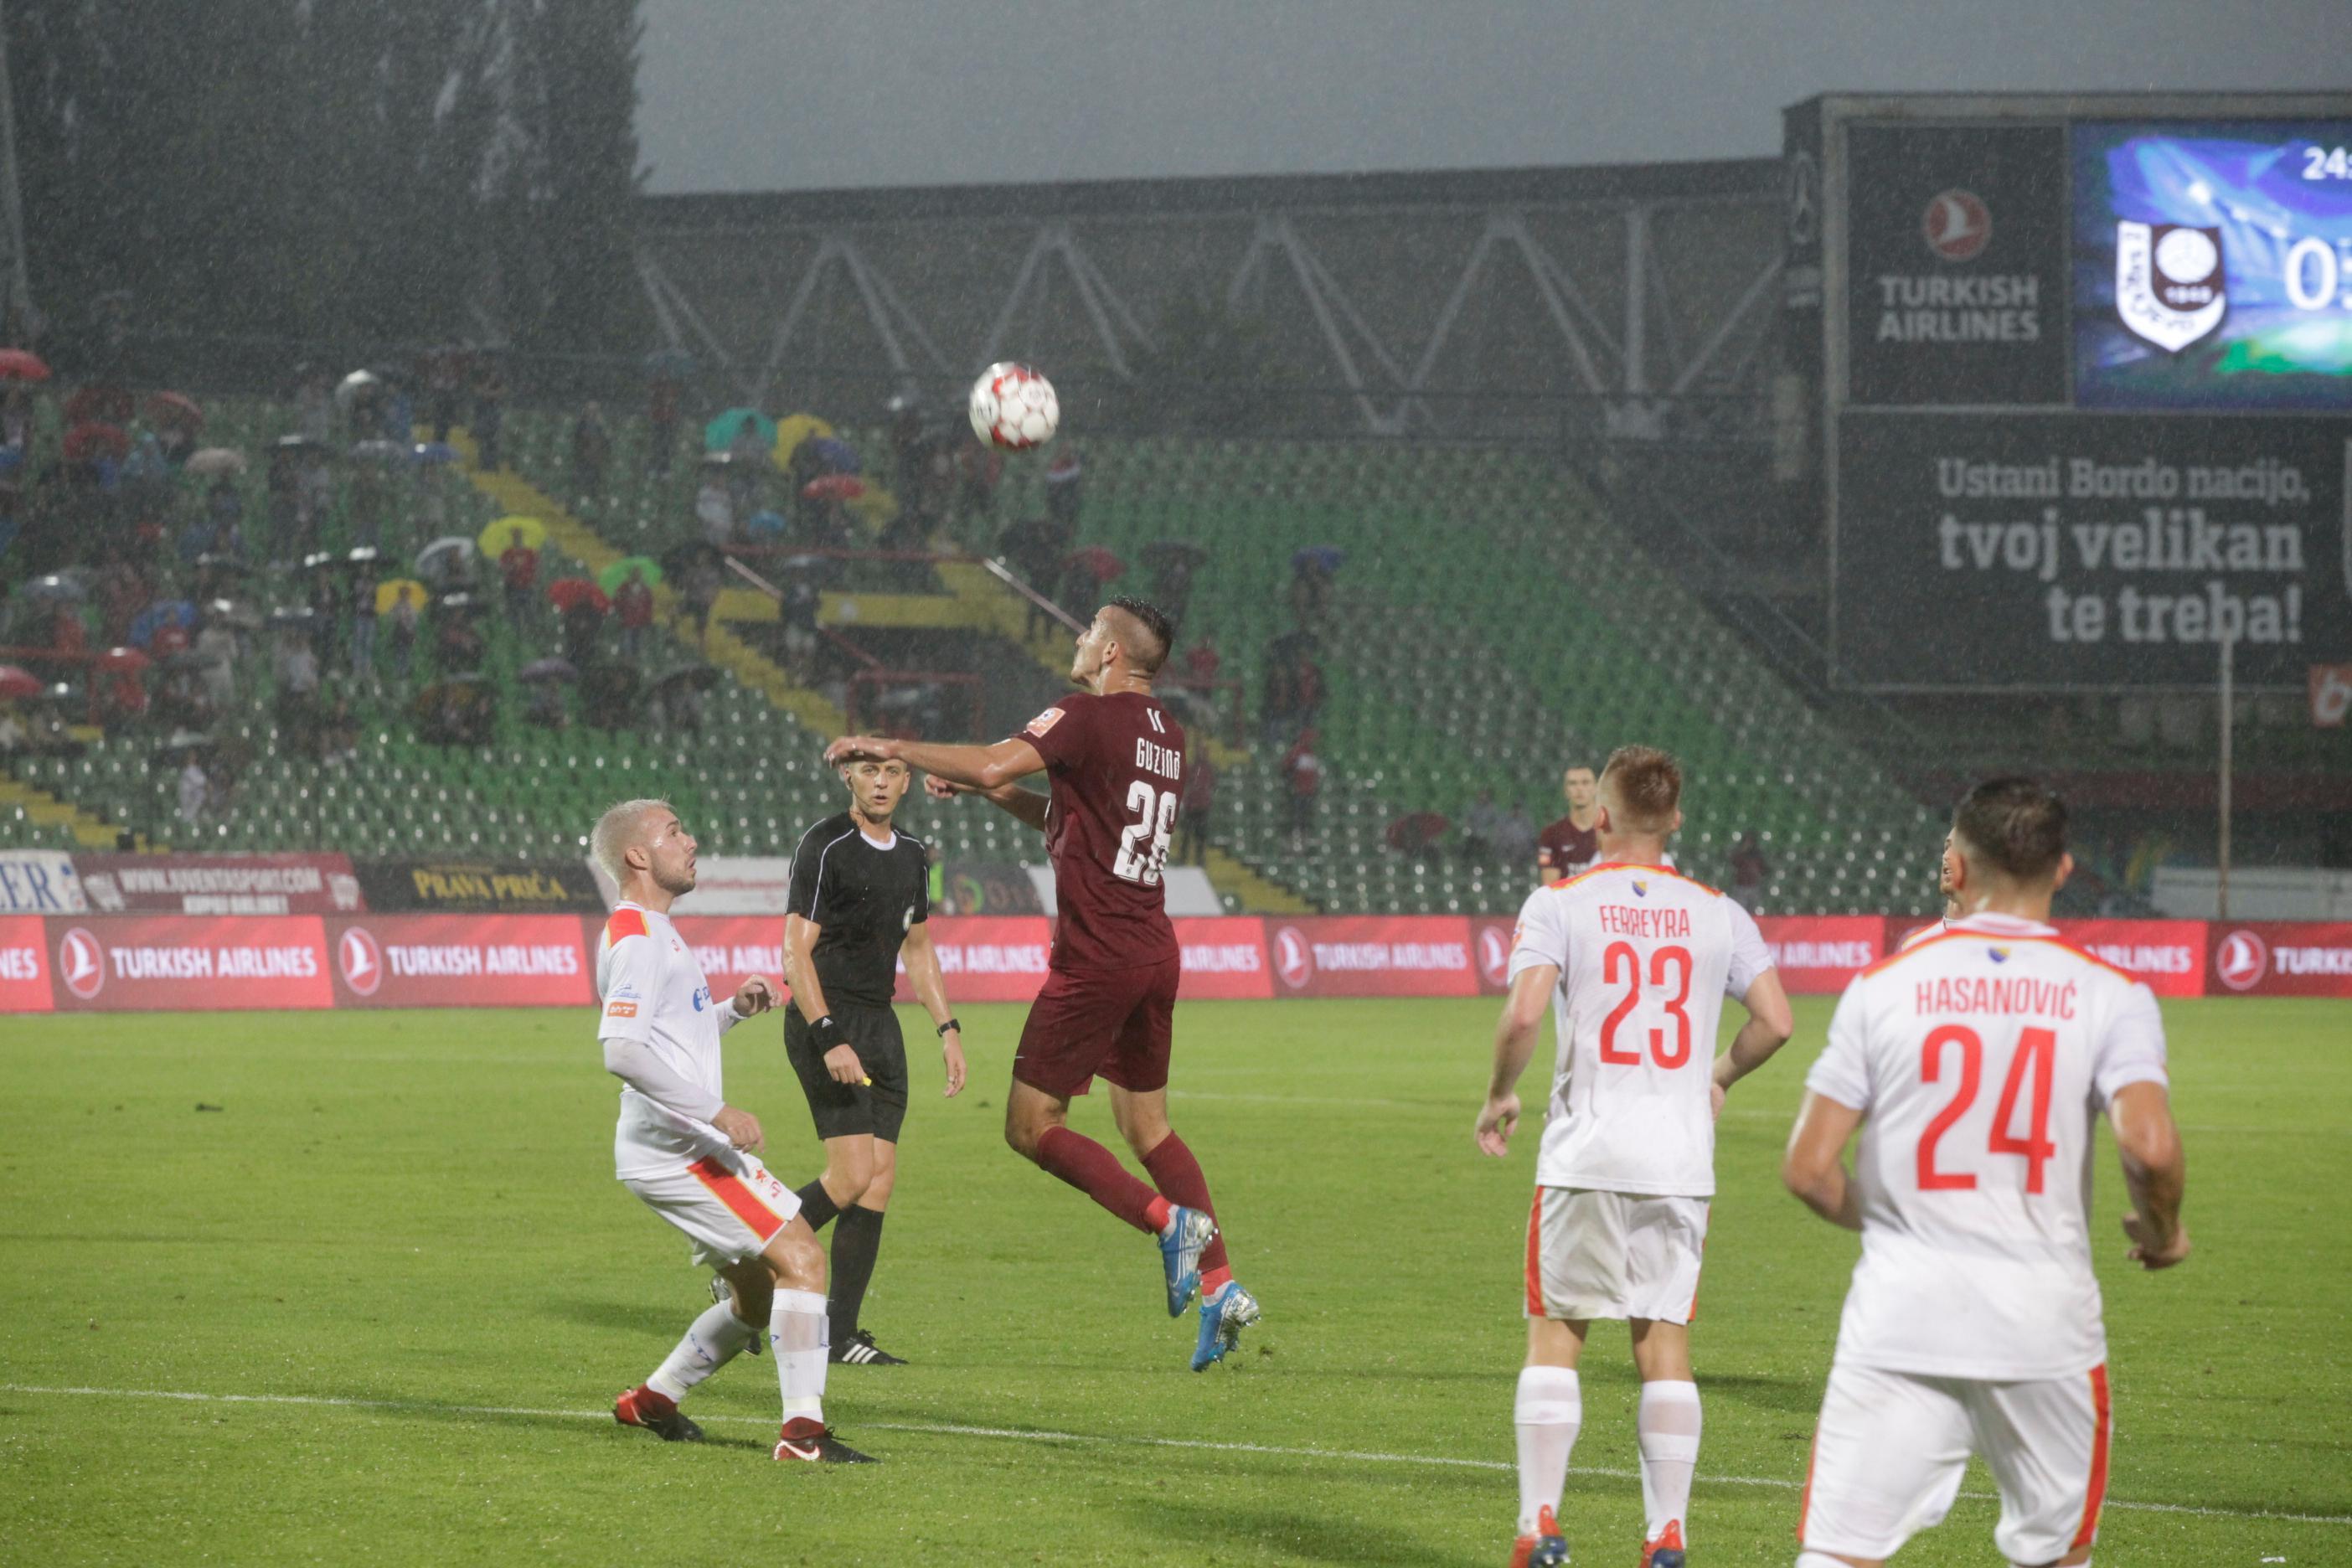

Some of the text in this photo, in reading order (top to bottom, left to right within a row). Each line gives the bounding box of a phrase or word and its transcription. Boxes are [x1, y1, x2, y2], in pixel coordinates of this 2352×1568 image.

[1879, 275, 2040, 307] TURKISH
[1877, 309, 2040, 341] AIRLINES
[1937, 456, 2310, 505] Ustani Bordo nacijo,
[1938, 506, 2303, 581] tvoj velikan
[2046, 581, 2303, 643] te treba!
[0, 864, 62, 909] ER
[1599, 905, 1691, 939] FERREYRA
[111, 946, 317, 978] TURKISH AIRLINES
[386, 945, 579, 975] TURKISH AIRLINES
[967, 945, 1047, 973] AIRLINES
[1181, 945, 1261, 972] AIRLINES
[1313, 943, 1467, 970] TURKISH AIRLINES
[1783, 941, 1872, 968] AIRLINES
[2272, 947, 2352, 974] TURKI
[1600, 941, 1693, 1070] 23
[1916, 977, 2077, 1020] HASANOVIĆ
[1916, 1024, 2057, 1195] 24
